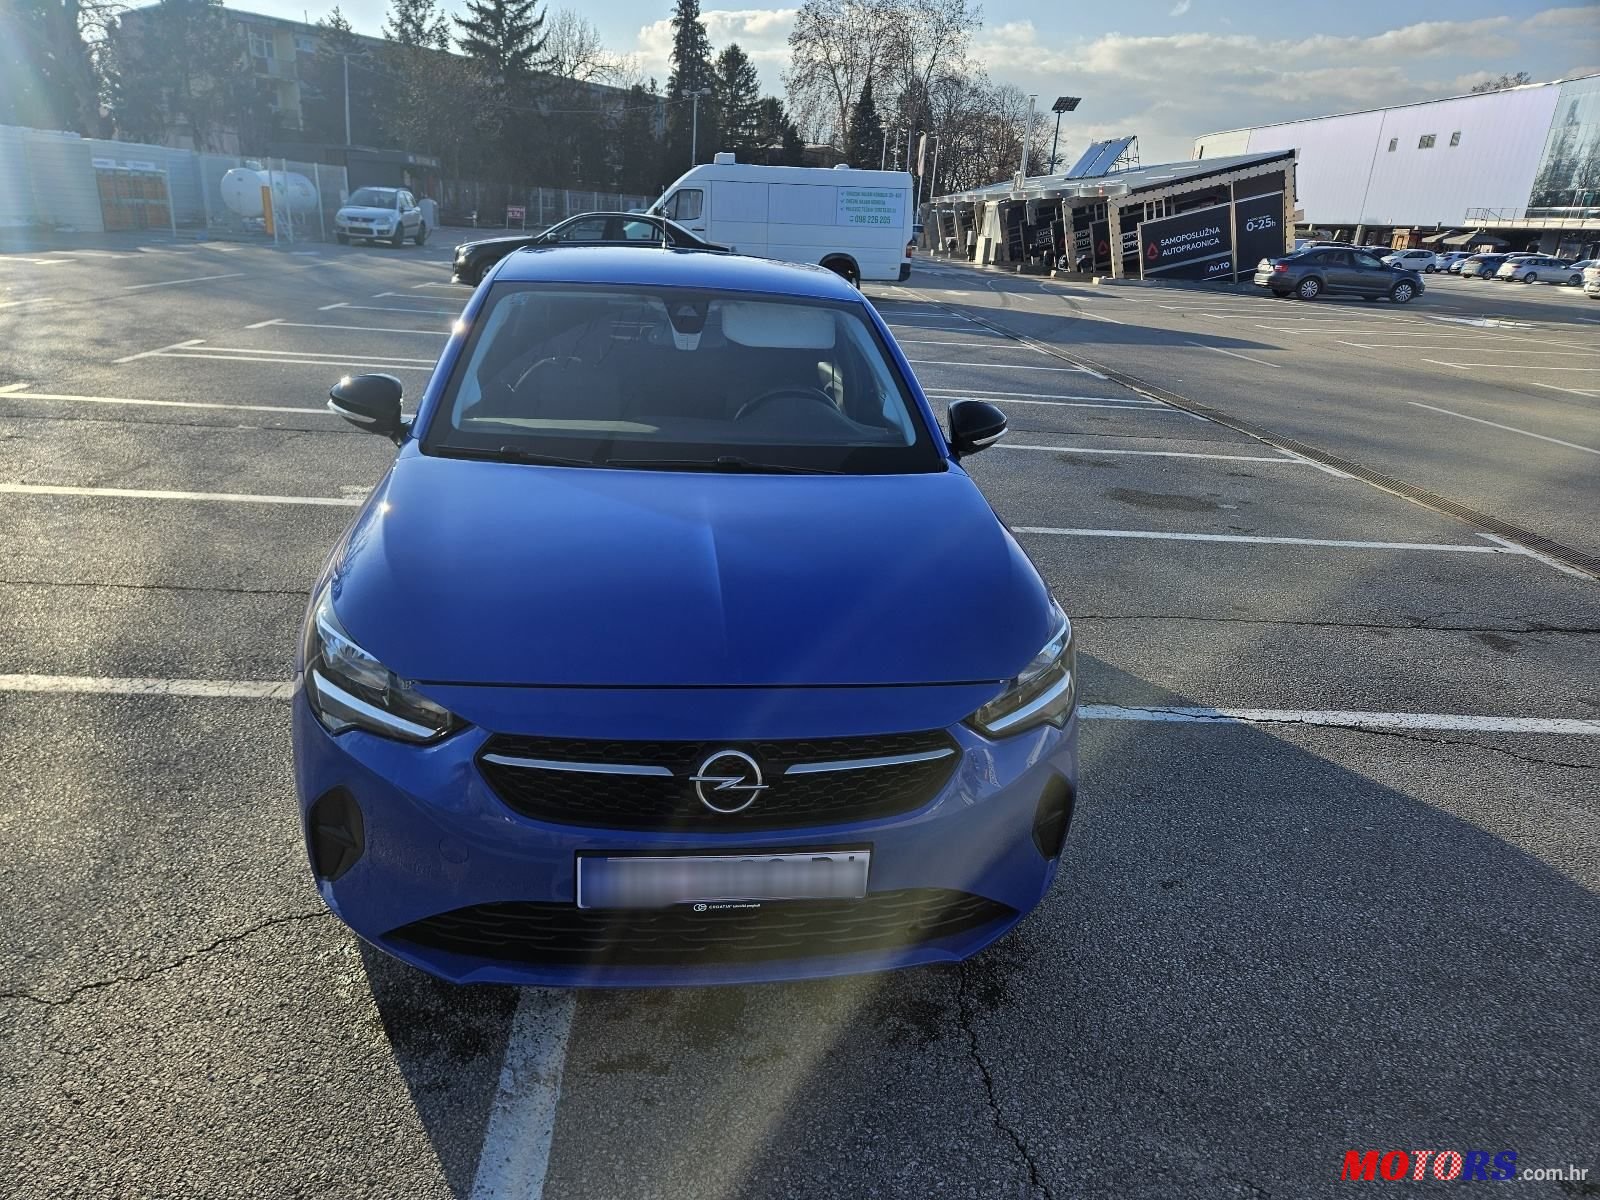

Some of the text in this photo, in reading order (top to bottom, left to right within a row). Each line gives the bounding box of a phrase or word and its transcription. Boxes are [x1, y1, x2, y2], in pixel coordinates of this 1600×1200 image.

[1246, 217, 1276, 232] 0-25h
[1160, 226, 1221, 246] SAMOPOSLUŽNA
[1161, 237, 1220, 257] AUTOPRAONICA
[1208, 261, 1230, 273] AUTO
